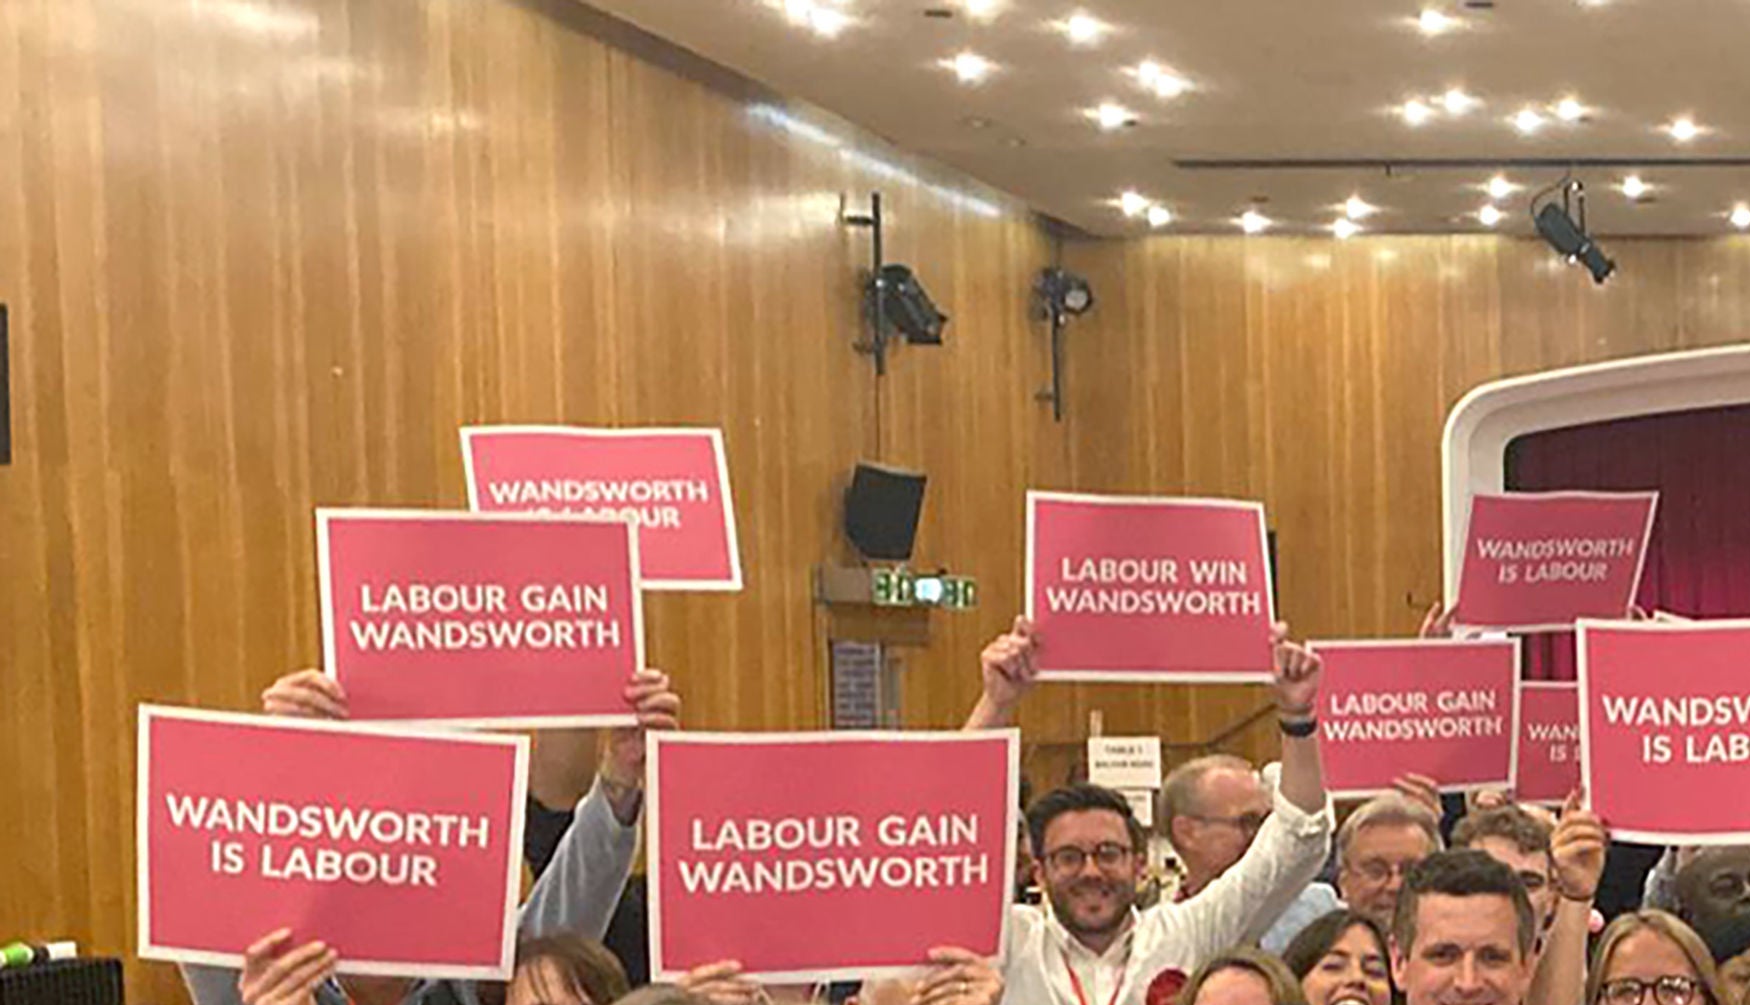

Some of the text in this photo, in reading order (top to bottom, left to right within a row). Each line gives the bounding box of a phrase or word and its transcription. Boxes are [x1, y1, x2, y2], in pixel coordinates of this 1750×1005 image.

[489, 479, 708, 505] WANDSWORTH
[1476, 538, 1634, 560] WANDSWORTH
[1062, 557, 1248, 586] LABOUR WIN
[1498, 561, 1608, 583] IS LABOUR
[362, 583, 608, 614] LABOUR GAIN
[1046, 588, 1262, 617] WANDSWORTH
[351, 618, 621, 651] WANDSWORTH
[1329, 690, 1496, 716] LABOUR GAIN
[1322, 717, 1503, 742] WANDSWORTH
[1549, 743, 1567, 762] IS
[1642, 735, 1672, 763] IS
[166, 793, 489, 848] WANDSWORTH
[692, 813, 978, 852] LABOUR GAIN
[211, 840, 437, 887] IS LABOUR
[679, 853, 988, 893] WANDSWORTH
